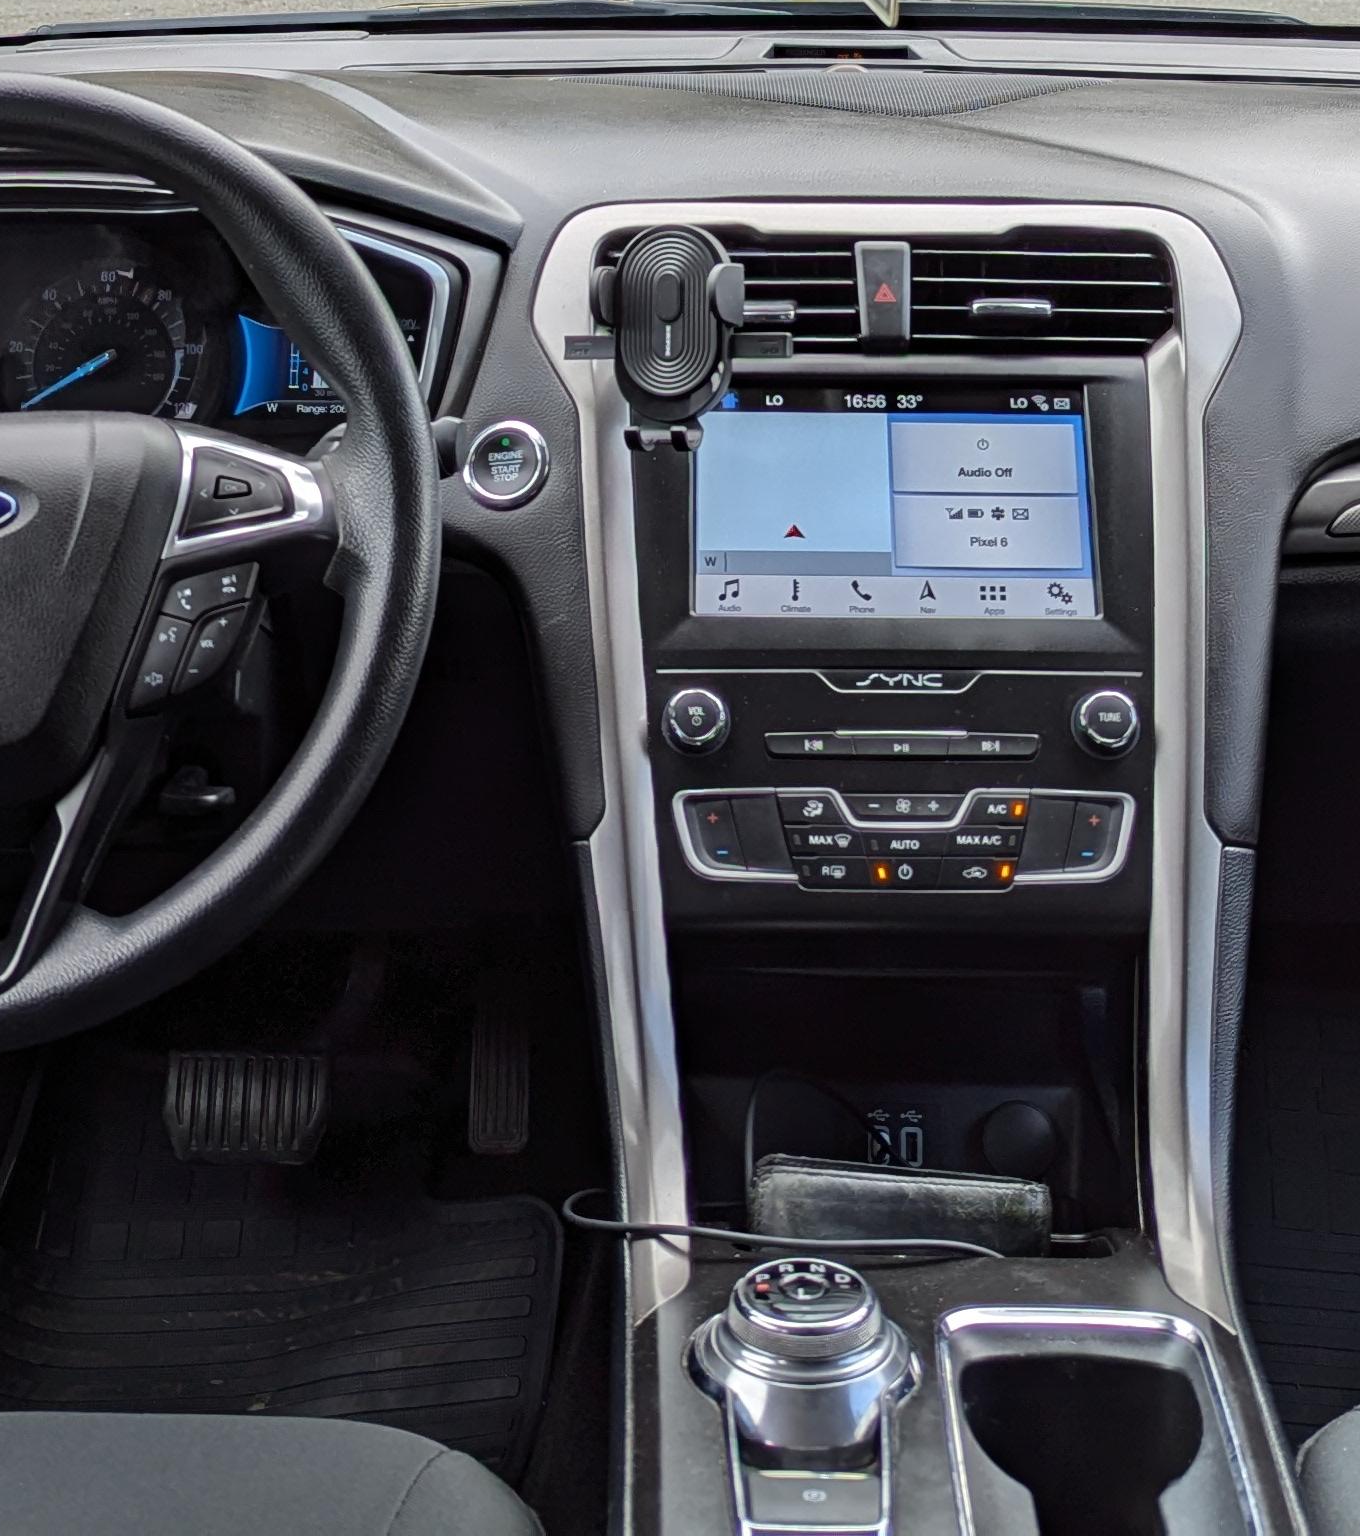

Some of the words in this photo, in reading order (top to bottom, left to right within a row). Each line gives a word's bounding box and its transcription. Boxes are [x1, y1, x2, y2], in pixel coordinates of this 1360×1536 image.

[101, 271, 116, 282] 60
[42, 289, 57, 301] 40
[157, 289, 172, 301] 80
[9, 341, 23, 353] 20
[185, 344, 204, 354] 100
[765, 395, 784, 407] LO
[843, 394, 887, 409] 16:56
[1010, 396, 1028, 409] LO
[266, 403, 279, 413] W
[296, 404, 328, 415] Range:
[488, 449, 523, 462] ENGINE
[490, 464, 520, 475] START
[957, 467, 992, 478] Audio
[994, 466, 1013, 478] Off
[493, 473, 519, 482] STOP
[969, 536, 997, 549] Pixel
[1000, 537, 1008, 548] 6
[704, 556, 717, 567] W
[717, 603, 742, 613] Audio
[780, 604, 811, 613] Climate
[848, 604, 875, 614] Phone
[919, 606, 936, 615] Nav
[984, 606, 1006, 617] Apps
[1044, 607, 1078, 617] Settings
[855, 672, 943, 687] SYNC
[687, 705, 706, 716] VOL
[1098, 711, 1121, 723] TUNE
[987, 803, 1007, 815] A/C
[808, 834, 834, 846] MAX
[889, 839, 920, 851] AUTO
[956, 834, 981, 846] MAX
[981, 834, 1002, 846] A/C
[778, 1264, 795, 1273] R
[809, 1264, 827, 1273] N
[755, 1273, 770, 1283] P
[834, 1273, 851, 1283] D
